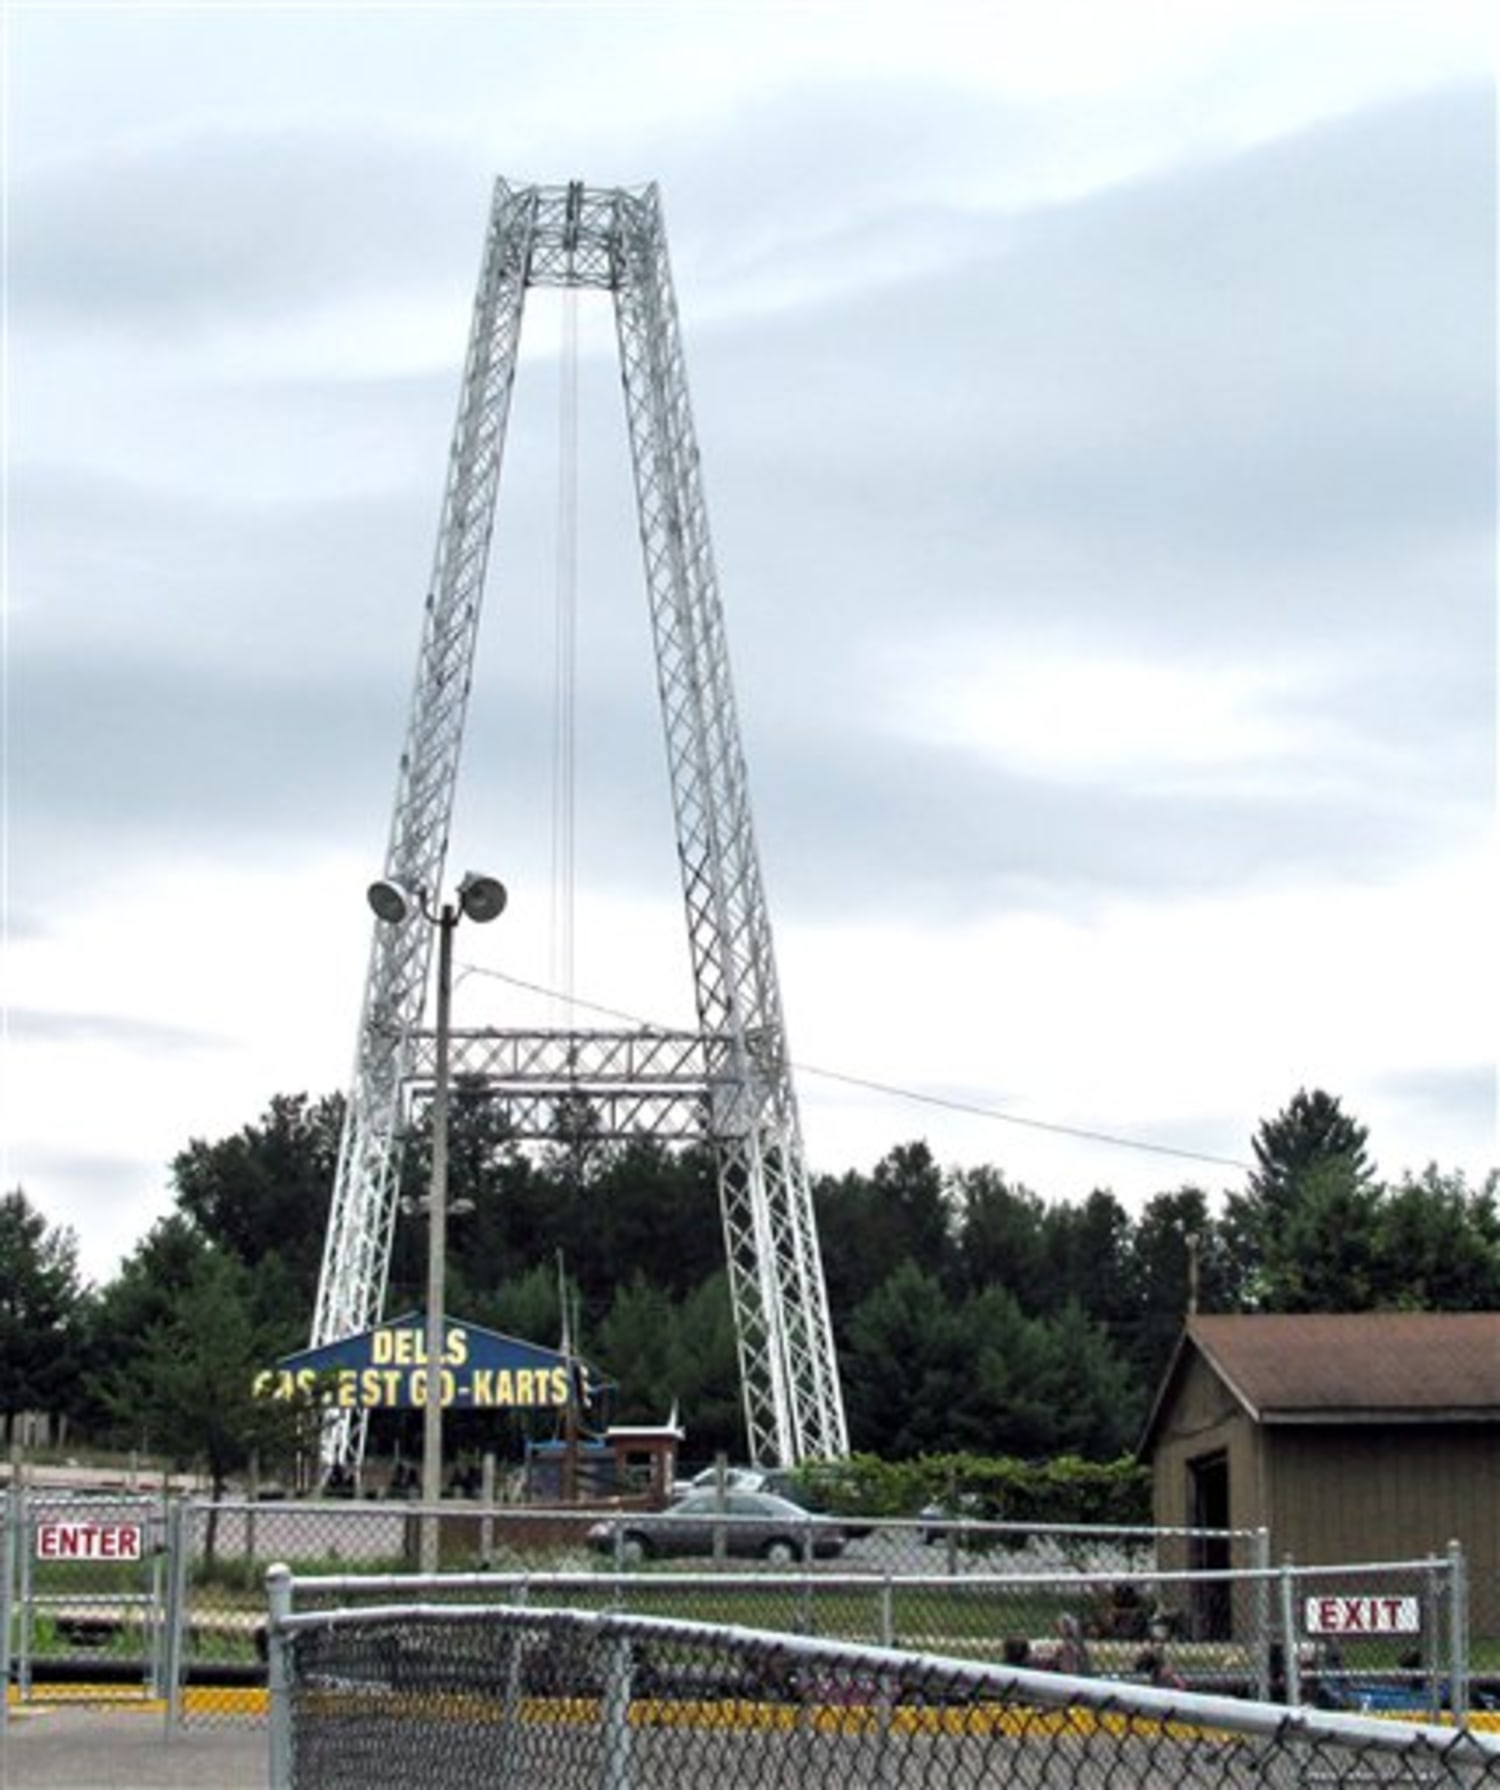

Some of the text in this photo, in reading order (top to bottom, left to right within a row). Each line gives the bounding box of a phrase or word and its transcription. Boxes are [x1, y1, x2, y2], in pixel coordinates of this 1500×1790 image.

[371, 1328, 468, 1366] DELS
[252, 1369, 401, 1407] FASEST
[40, 1527, 137, 1556] ENTER
[1320, 1600, 1402, 1629] EXIT
